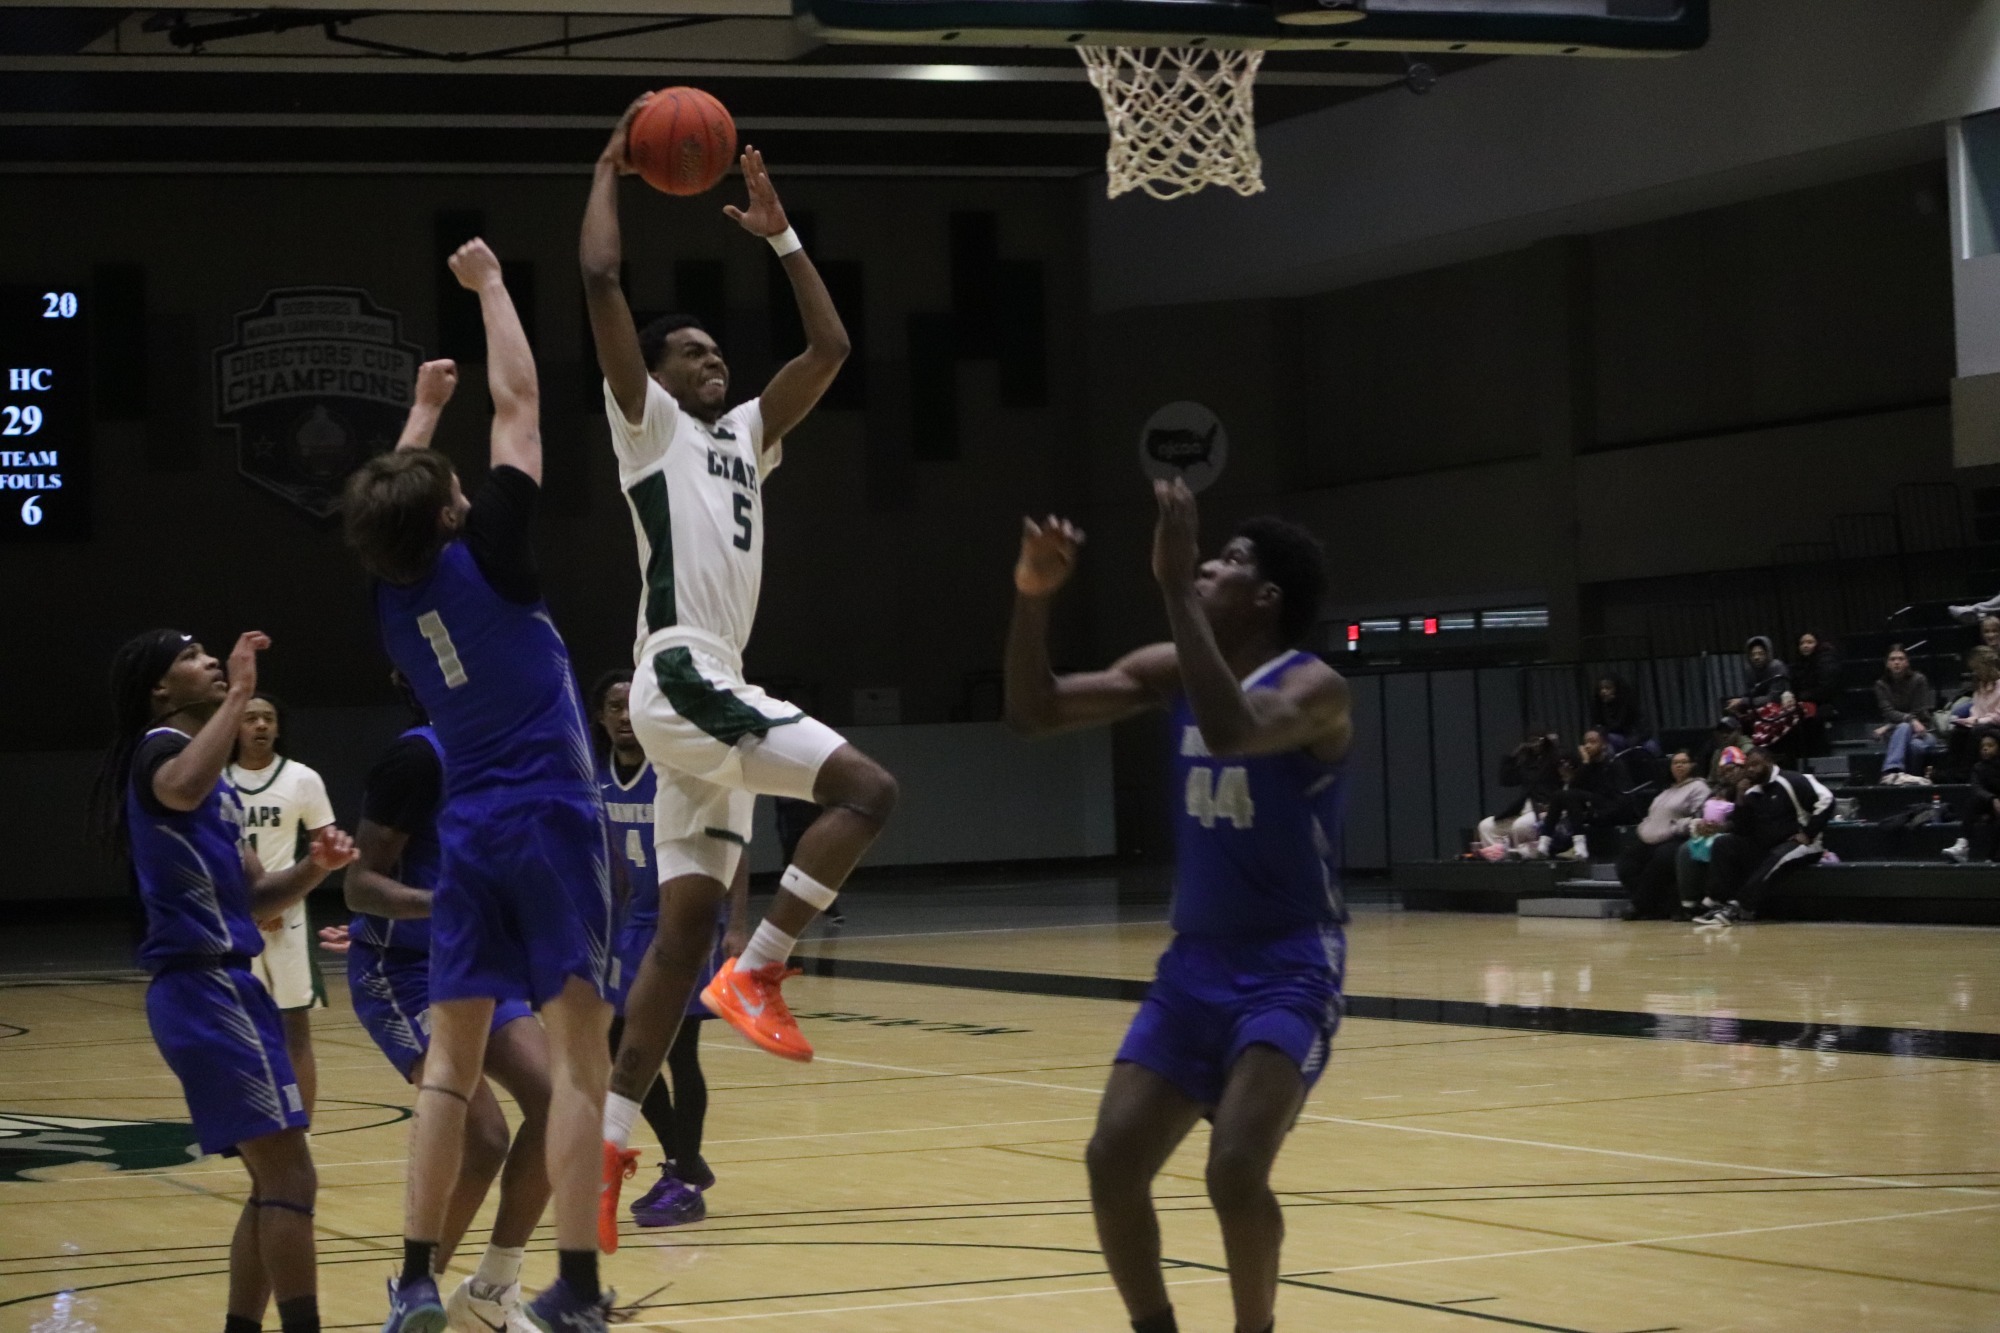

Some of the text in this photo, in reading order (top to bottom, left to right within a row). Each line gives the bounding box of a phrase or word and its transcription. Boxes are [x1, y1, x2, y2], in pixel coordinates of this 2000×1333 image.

[42, 292, 78, 318] 20
[362, 348, 405, 372] CUP
[9, 368, 53, 392] HC
[227, 368, 409, 405] CHAMPIONS
[1, 405, 44, 436] 29
[0, 451, 58, 467] TEAM
[0, 473, 62, 489] FOULS
[21, 495, 43, 526] 6
[733, 492, 752, 552] 5
[417, 609, 469, 689] 1
[1184, 765, 1255, 829] 44
[243, 806, 281, 827] APS
[625, 829, 647, 868] 4
